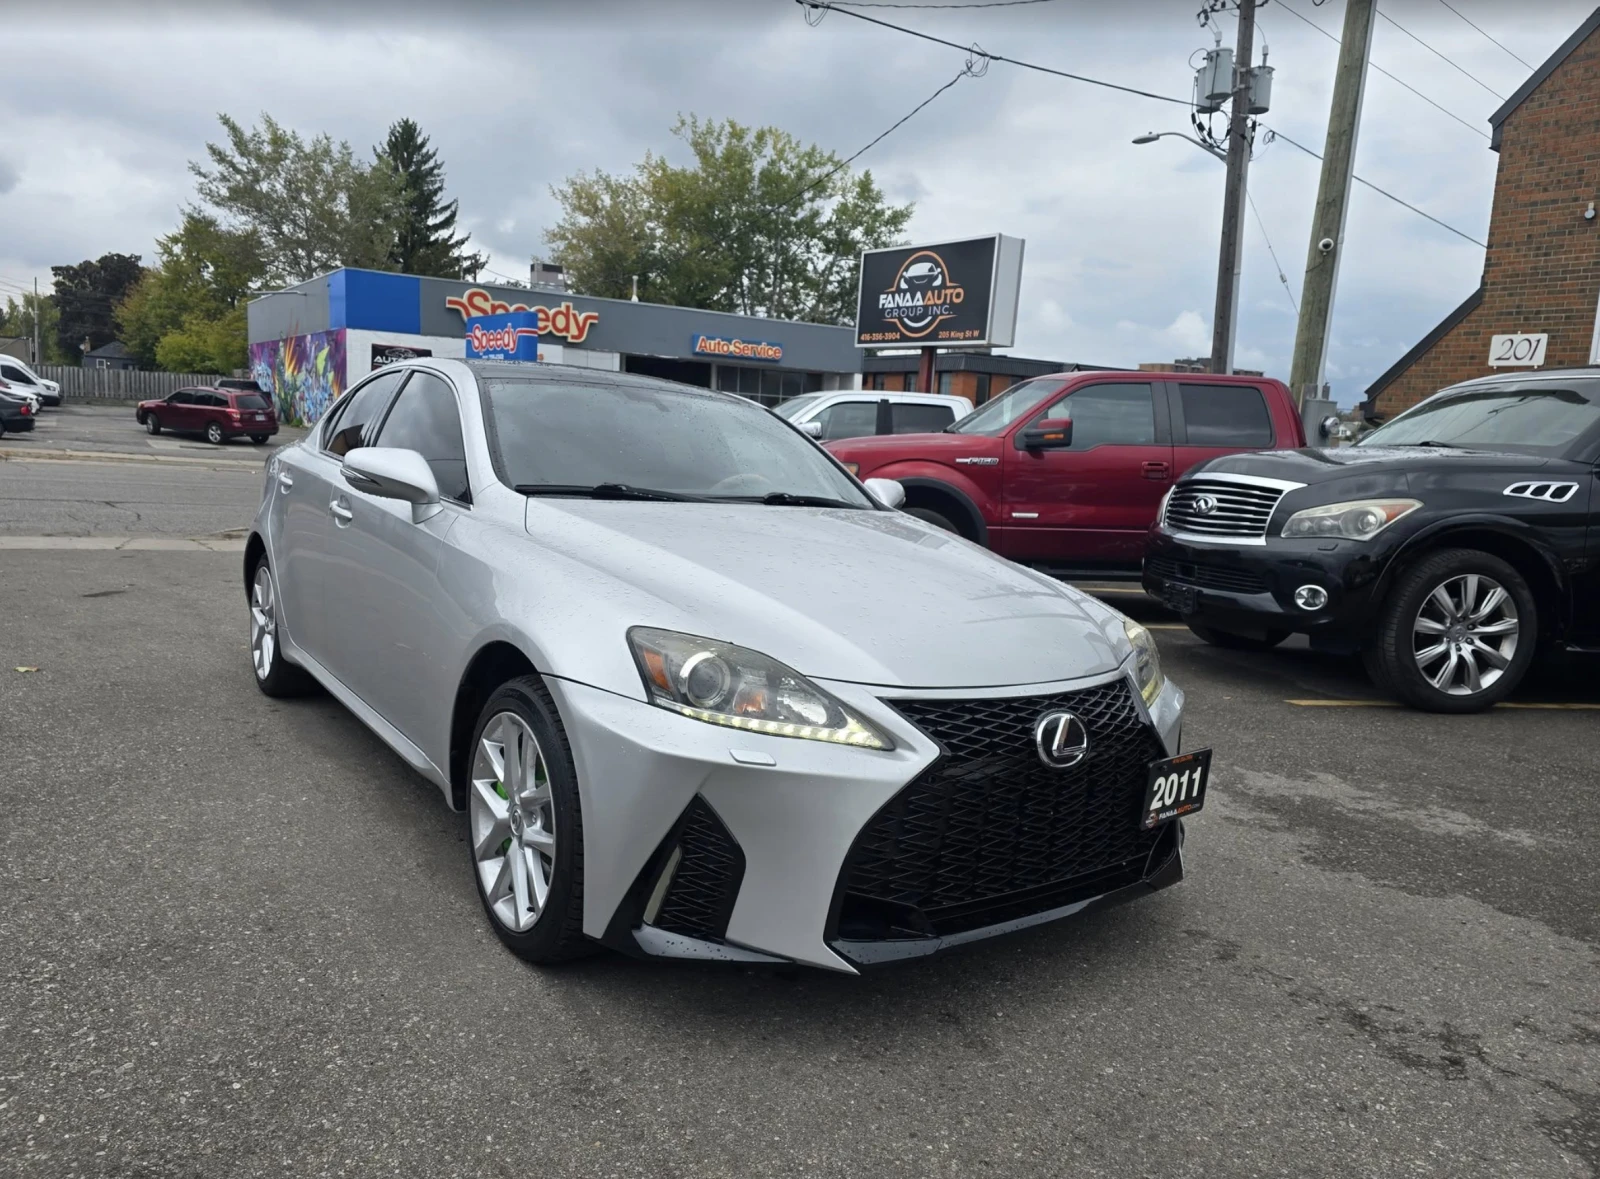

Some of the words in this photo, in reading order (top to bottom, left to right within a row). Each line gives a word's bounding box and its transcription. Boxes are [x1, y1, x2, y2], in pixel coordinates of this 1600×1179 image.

[885, 307, 923, 318] GROUP
[929, 305, 953, 315] INC.
[468, 323, 520, 354] Speedy
[950, 331, 964, 340] King
[965, 330, 974, 338] St
[973, 330, 980, 338] W
[696, 335, 730, 355] Auto
[732, 339, 783, 359] Service
[1494, 338, 1542, 361] 201
[1149, 766, 1202, 811] 2011
